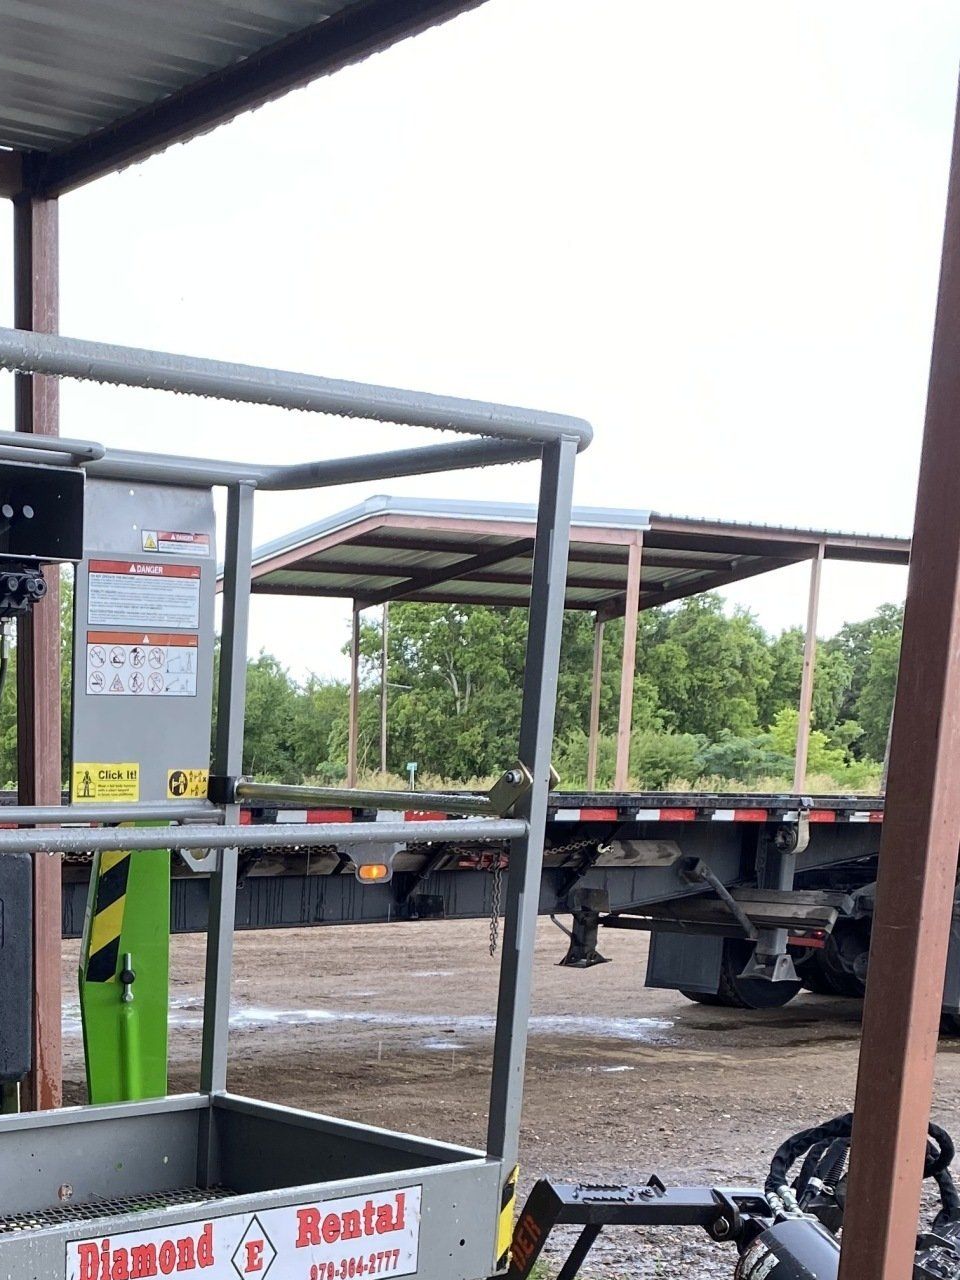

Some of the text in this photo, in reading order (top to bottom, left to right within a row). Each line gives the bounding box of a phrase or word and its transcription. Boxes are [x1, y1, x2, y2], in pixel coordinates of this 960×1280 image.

[175, 534, 194, 542] DANGER
[136, 565, 164, 575] DANGER
[98, 770, 137, 780] Click It!
[244, 1239, 264, 1273] E
[296, 1193, 406, 1248] Rental
